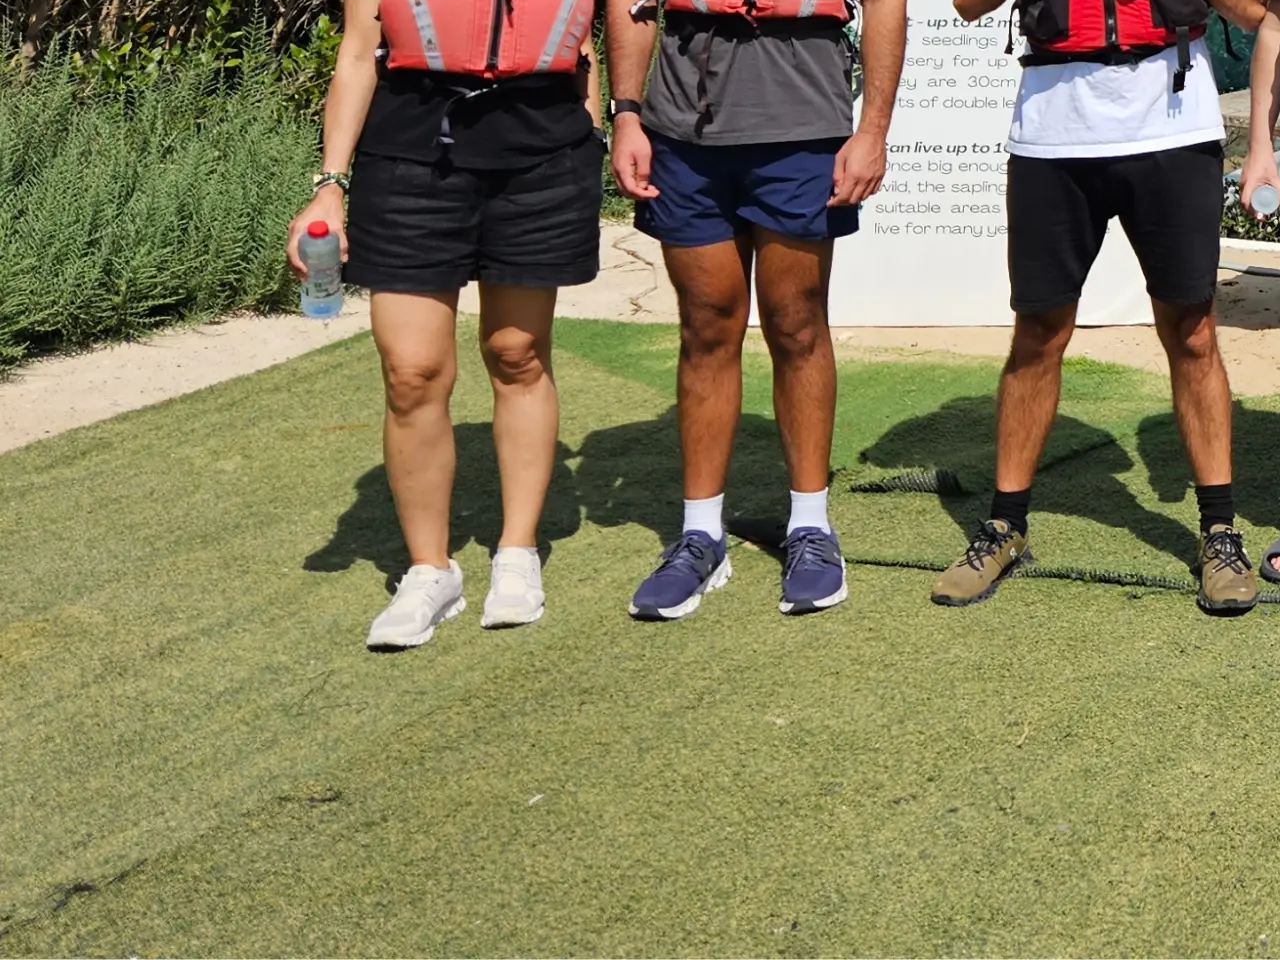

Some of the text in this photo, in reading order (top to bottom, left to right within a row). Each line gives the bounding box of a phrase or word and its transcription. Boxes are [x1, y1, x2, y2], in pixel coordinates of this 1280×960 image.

[927, 18, 948, 30] up
[952, 17, 971, 28] to
[922, 34, 998, 49] seedlings
[906, 54, 1008, 70] sery for up
[899, 75, 1016, 90] ey are 30cm
[898, 98, 915, 108] ts
[919, 96, 939, 108] of
[942, 96, 998, 109] double
[885, 142, 911, 154] an
[914, 141, 943, 154] live
[946, 144, 968, 156] up
[971, 142, 990, 154] to
[928, 160, 953, 175] big
[958, 162, 1008, 175] enoug
[917, 181, 945, 193] the
[875, 201, 1000, 213] suitable areas
[874, 222, 1008, 238] live for many ye
